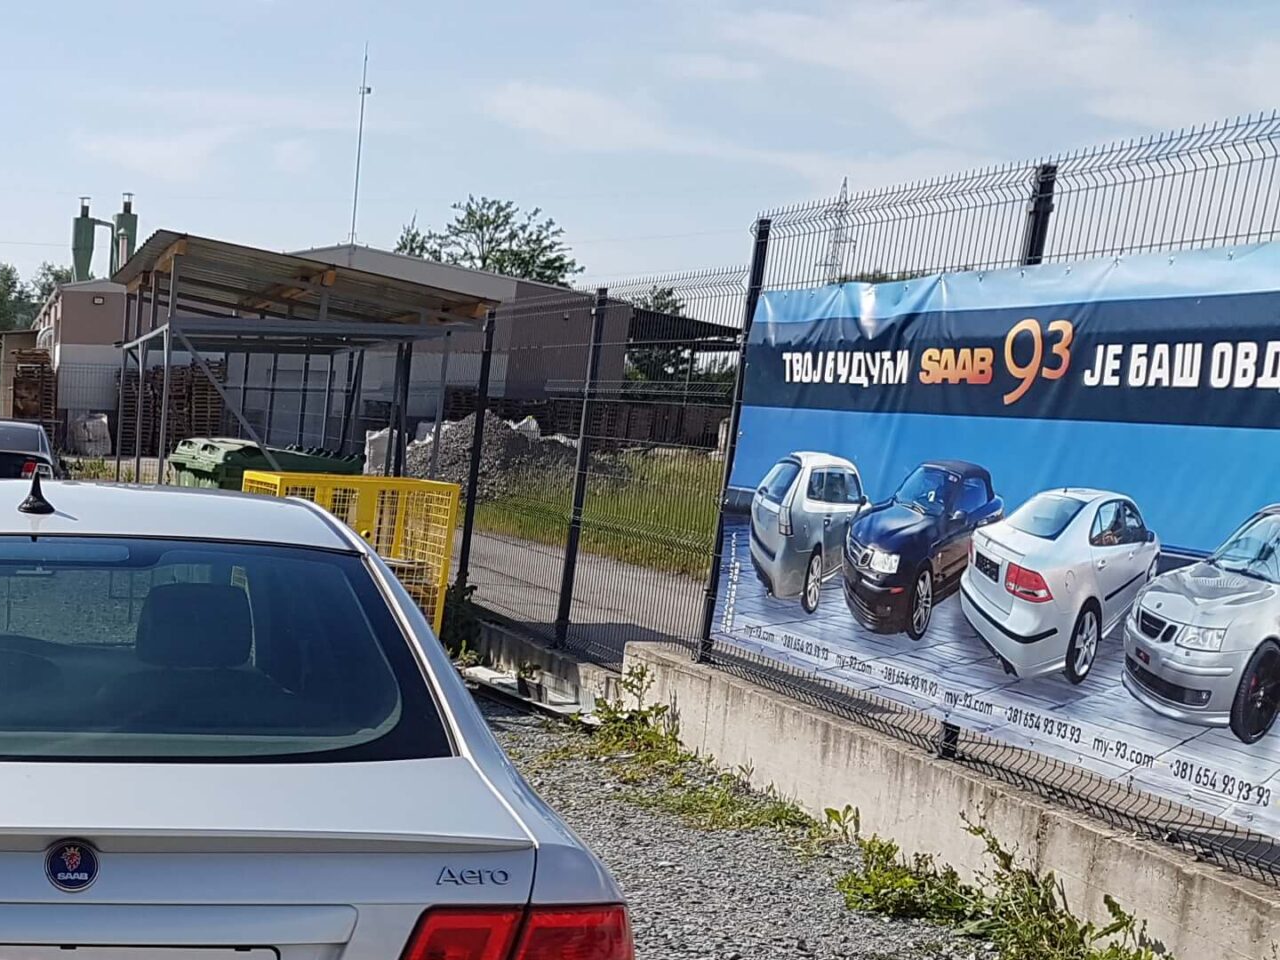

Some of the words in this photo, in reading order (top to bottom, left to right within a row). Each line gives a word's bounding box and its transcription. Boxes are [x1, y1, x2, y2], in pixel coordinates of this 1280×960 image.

[782, 350, 825, 384] ТВОЈ
[919, 347, 994, 385] SAAB
[1003, 318, 1074, 405] 93
[1083, 344, 1124, 387] ЈЕ
[1128, 343, 1203, 388] БАШ
[1043, 718, 1055, 736] 93
[1056, 722, 1068, 740] 93
[1069, 726, 1082, 744] 93
[1092, 737, 1154, 769] my-93.com
[1195, 766, 1217, 790] 654
[1222, 774, 1236, 796] 93
[1237, 780, 1252, 801] 93
[1256, 786, 1271, 807] 93
[57, 872, 89, 881] SAAB
[435, 865, 510, 886] Aero
